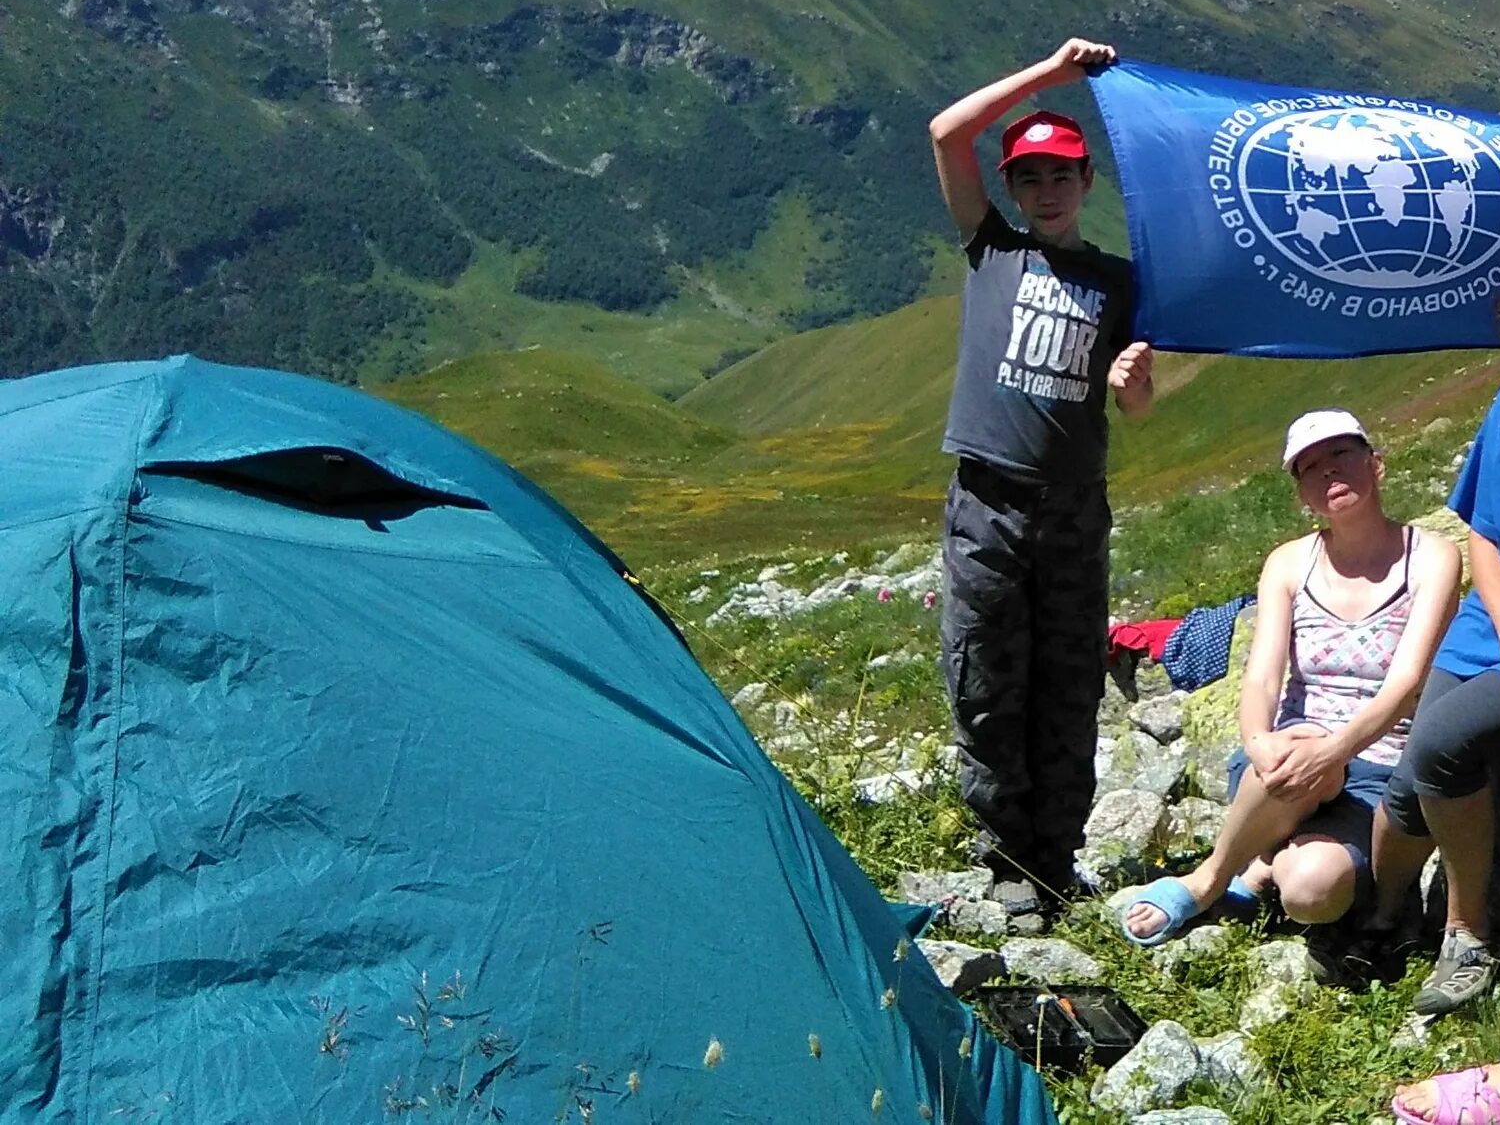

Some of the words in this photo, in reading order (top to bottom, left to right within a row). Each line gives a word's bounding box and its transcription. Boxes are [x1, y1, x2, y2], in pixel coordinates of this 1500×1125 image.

[1016, 272, 1106, 325] BECOME
[1005, 305, 1098, 377] YOUR
[997, 361, 1089, 402] PLAYGROUND
